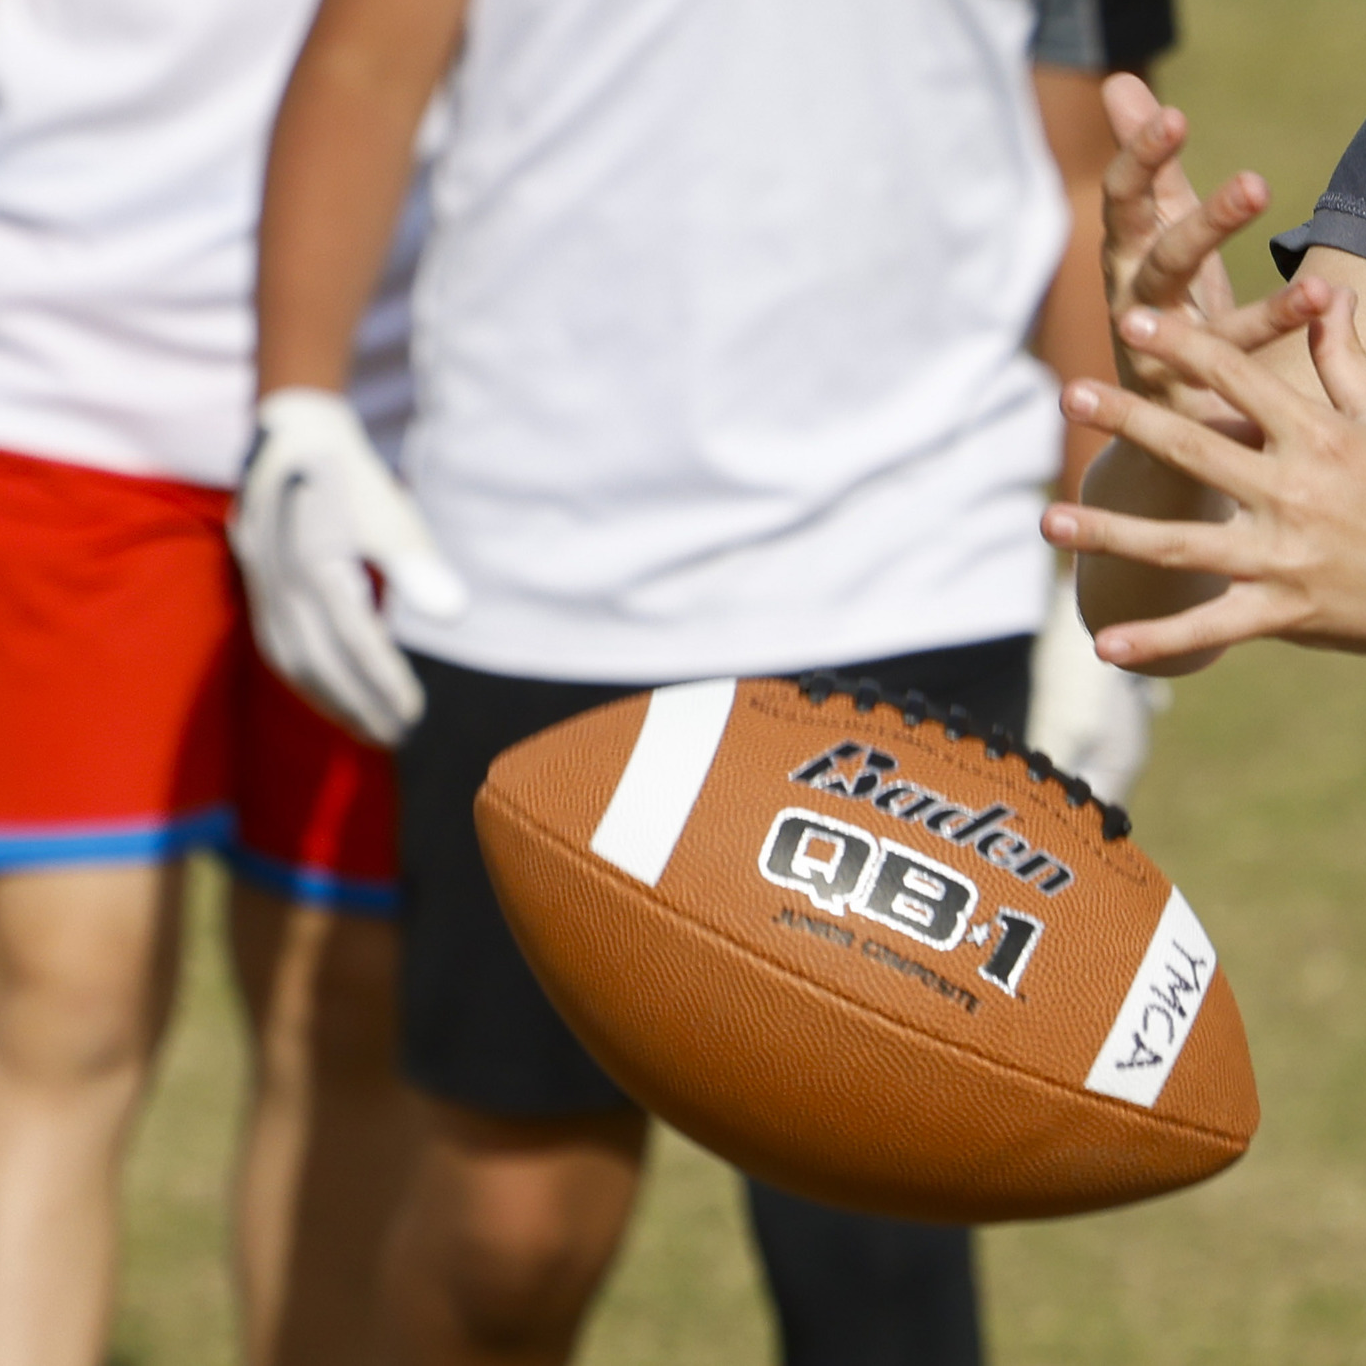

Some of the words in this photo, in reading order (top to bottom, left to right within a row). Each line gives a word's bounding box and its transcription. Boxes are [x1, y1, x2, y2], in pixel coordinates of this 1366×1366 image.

[788, 740, 1074, 897] Baden
[861, 939, 981, 1014] COMPOSITE
[1114, 939, 1207, 1070] YMCA
